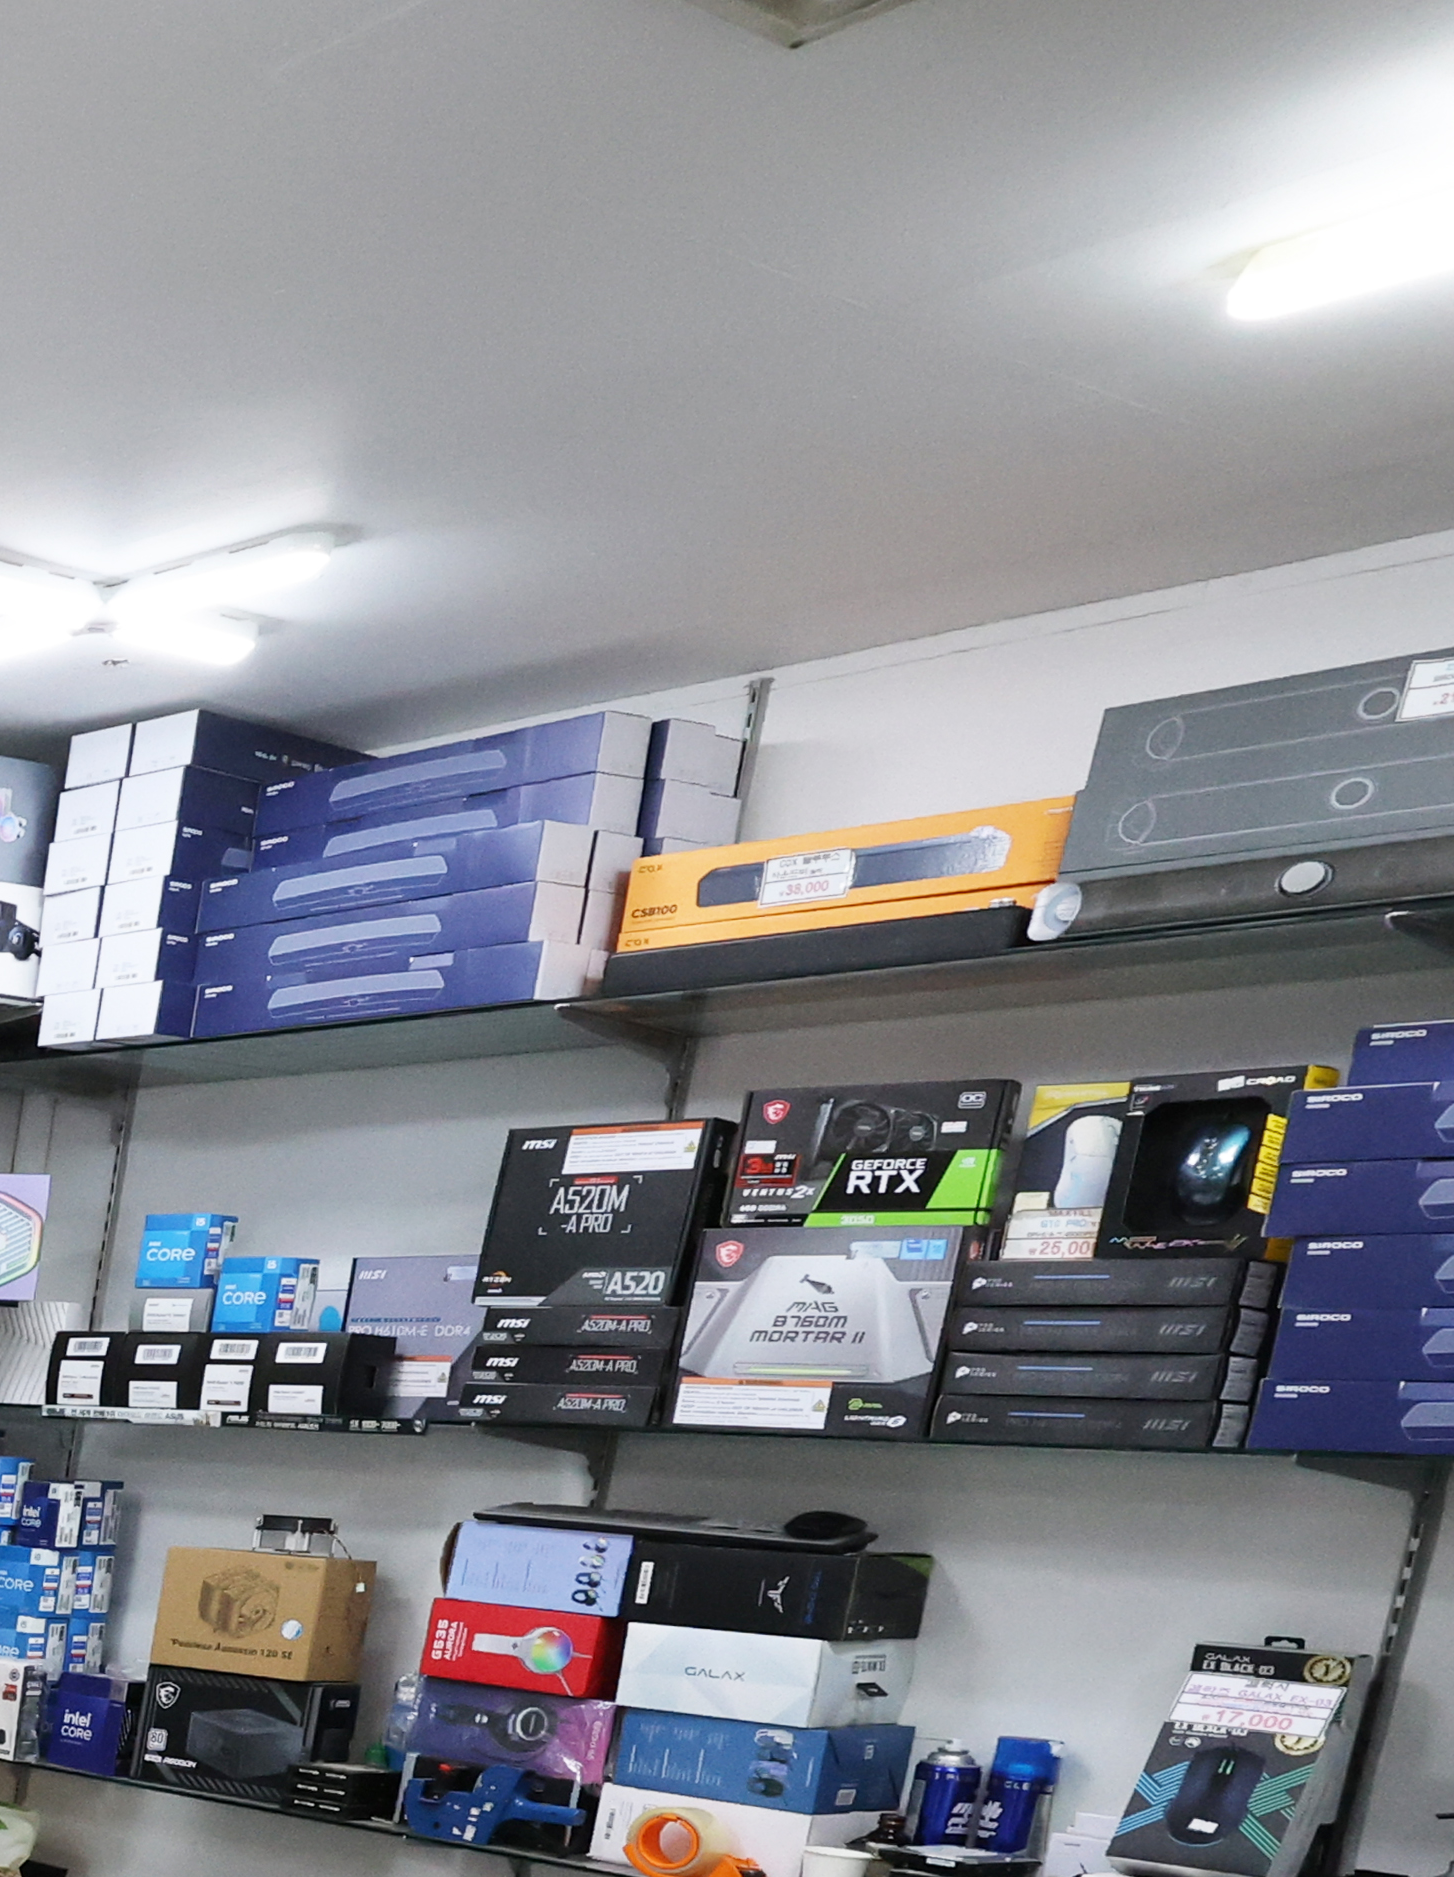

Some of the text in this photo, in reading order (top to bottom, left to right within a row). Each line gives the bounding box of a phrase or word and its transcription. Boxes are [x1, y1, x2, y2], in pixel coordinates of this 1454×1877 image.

[631, 904, 678, 920] CSB100
[1370, 1029, 1427, 1042] SIROCO
[1306, 1093, 1363, 1104] SIROCO
[522, 1137, 557, 1151] msi
[851, 1158, 927, 1171] GEFORCE
[845, 1170, 922, 1194] RTX
[550, 1185, 631, 1215] A520M
[584, 1213, 612, 1234] PRO
[607, 1271, 665, 1296] A520
[785, 1301, 839, 1314] MAG
[497, 1318, 531, 1329] msi
[773, 1315, 847, 1329] B760M
[434, 1324, 471, 1336] DDR4
[749, 1329, 845, 1344] MORTAR
[1204, 1653, 1251, 1663] GALAX
[684, 1666, 746, 1682] GALAX
